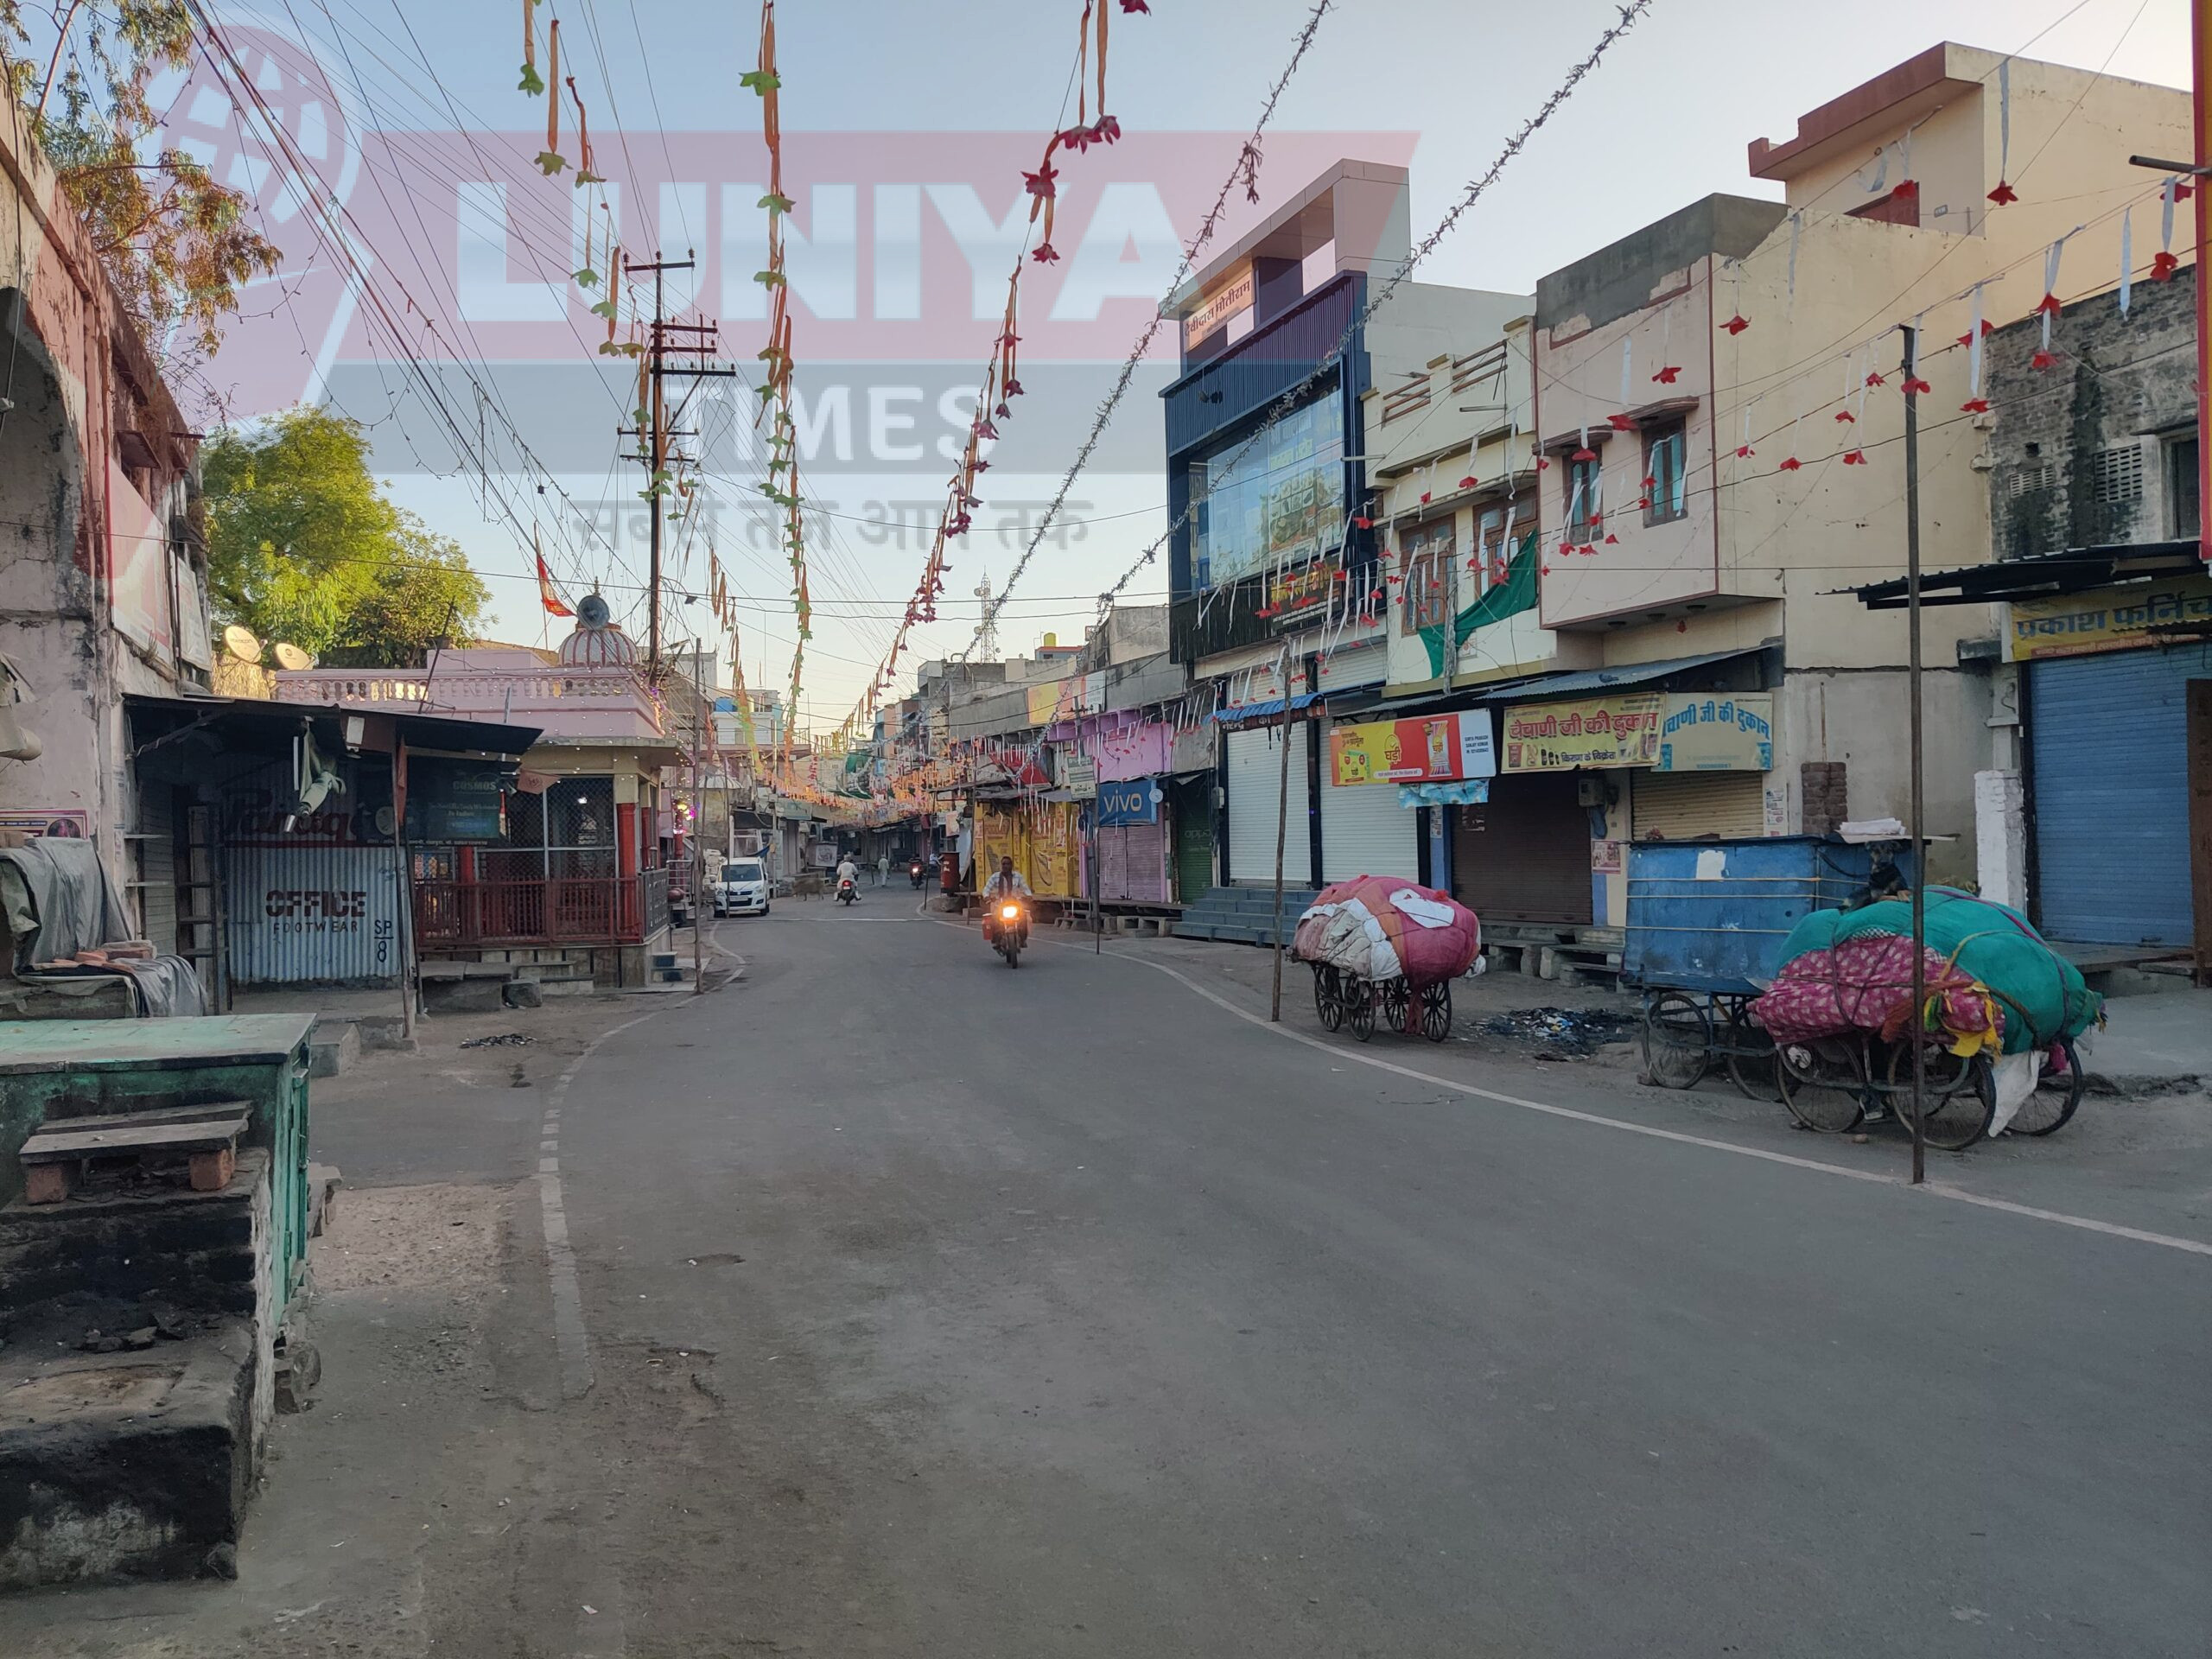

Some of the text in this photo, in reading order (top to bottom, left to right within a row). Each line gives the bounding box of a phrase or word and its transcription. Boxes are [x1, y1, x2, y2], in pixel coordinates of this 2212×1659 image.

[1215, 280, 1250, 313] मोतीराम
[2017, 610, 2107, 640] प्रकाश
[1560, 713, 1582, 735] जी
[1586, 710, 1611, 734] की
[1613, 712, 1658, 741] दुकान
[1662, 703, 1697, 737] चाणी
[1700, 701, 1715, 722] जी
[1718, 702, 1734, 723] की
[1737, 708, 1770, 740] दुकान
[1384, 746, 1402, 764] घड़ी
[1103, 788, 1142, 813] vivo
[265, 889, 367, 918] OFFICE
[273, 921, 359, 935] FOOTWEAR
[374, 919, 392, 935] SP
[378, 940, 388, 963] 8
